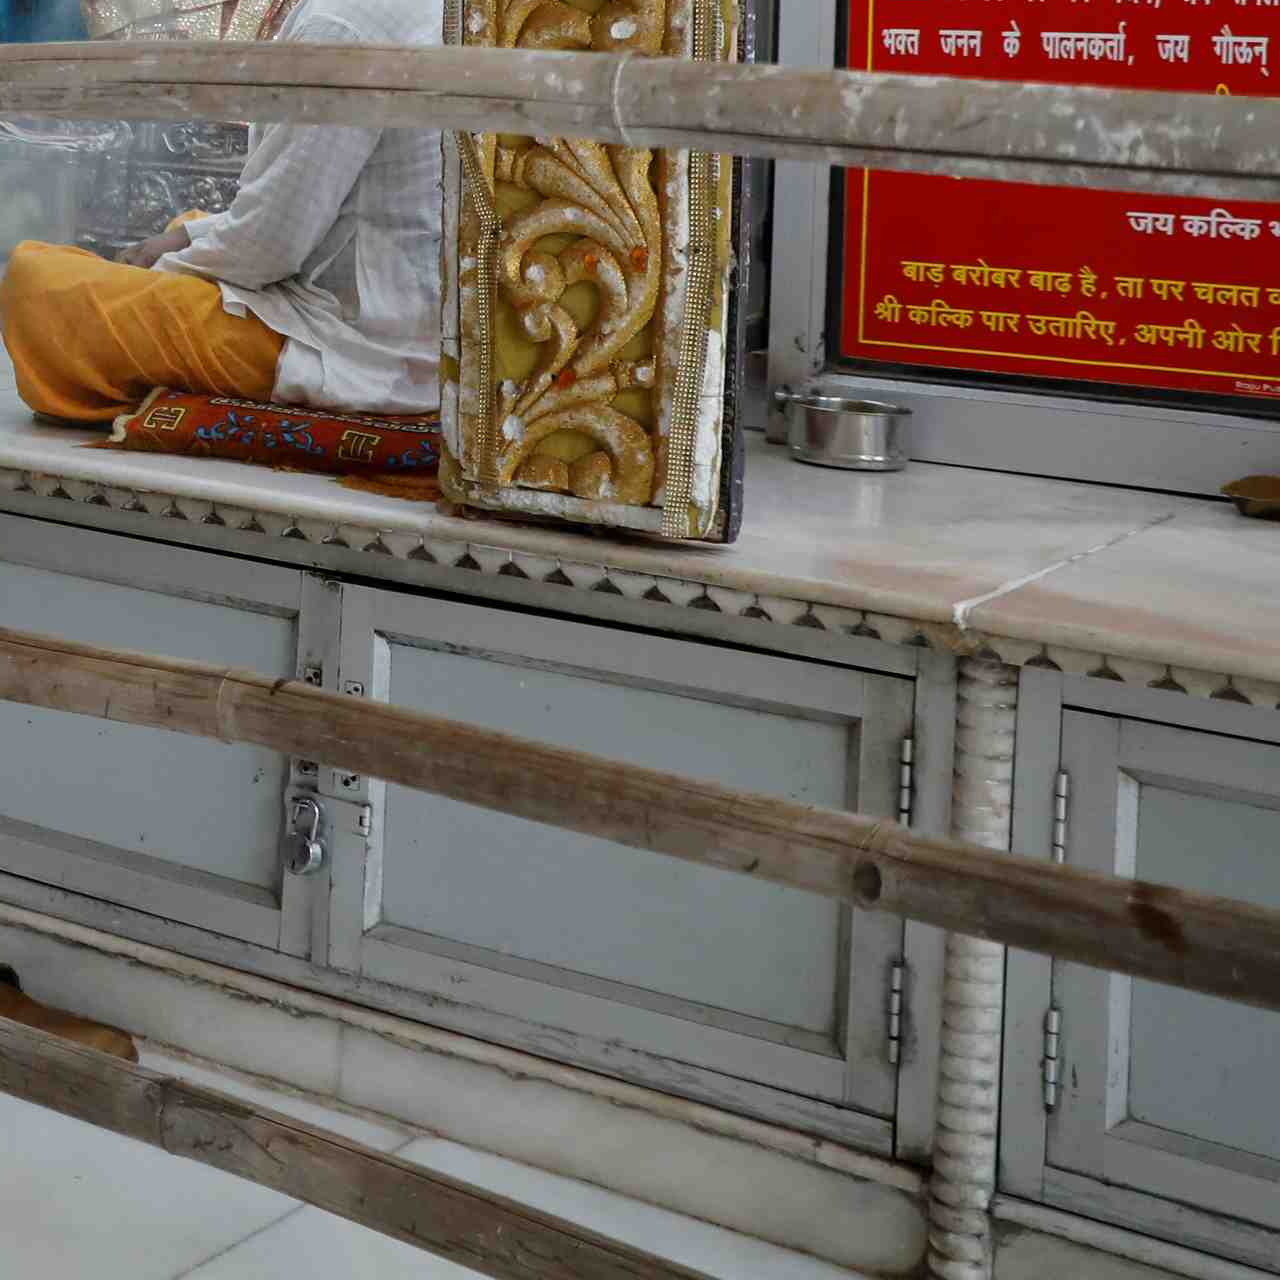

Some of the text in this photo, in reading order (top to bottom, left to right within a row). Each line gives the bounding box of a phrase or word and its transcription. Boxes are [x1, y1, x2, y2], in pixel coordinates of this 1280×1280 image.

[882, 29, 920, 55] भक्त
[939, 30, 982, 56] जनन
[1002, 20, 1021, 57] के
[1156, 35, 1190, 62] जय
[1126, 212, 1175, 235] जय
[1180, 208, 1262, 240] कल्कि
[950, 259, 1022, 288] बरोबर
[1114, 277, 1144, 298] ता
[1150, 280, 1185, 300] पर
[1192, 283, 1260, 307] चलत
[875, 295, 902, 322] श्री
[906, 300, 974, 328] कल्कि
[979, 311, 1020, 332] पार
[1135, 319, 1205, 348] अपनी
[1212, 324, 1262, 353] ओर
